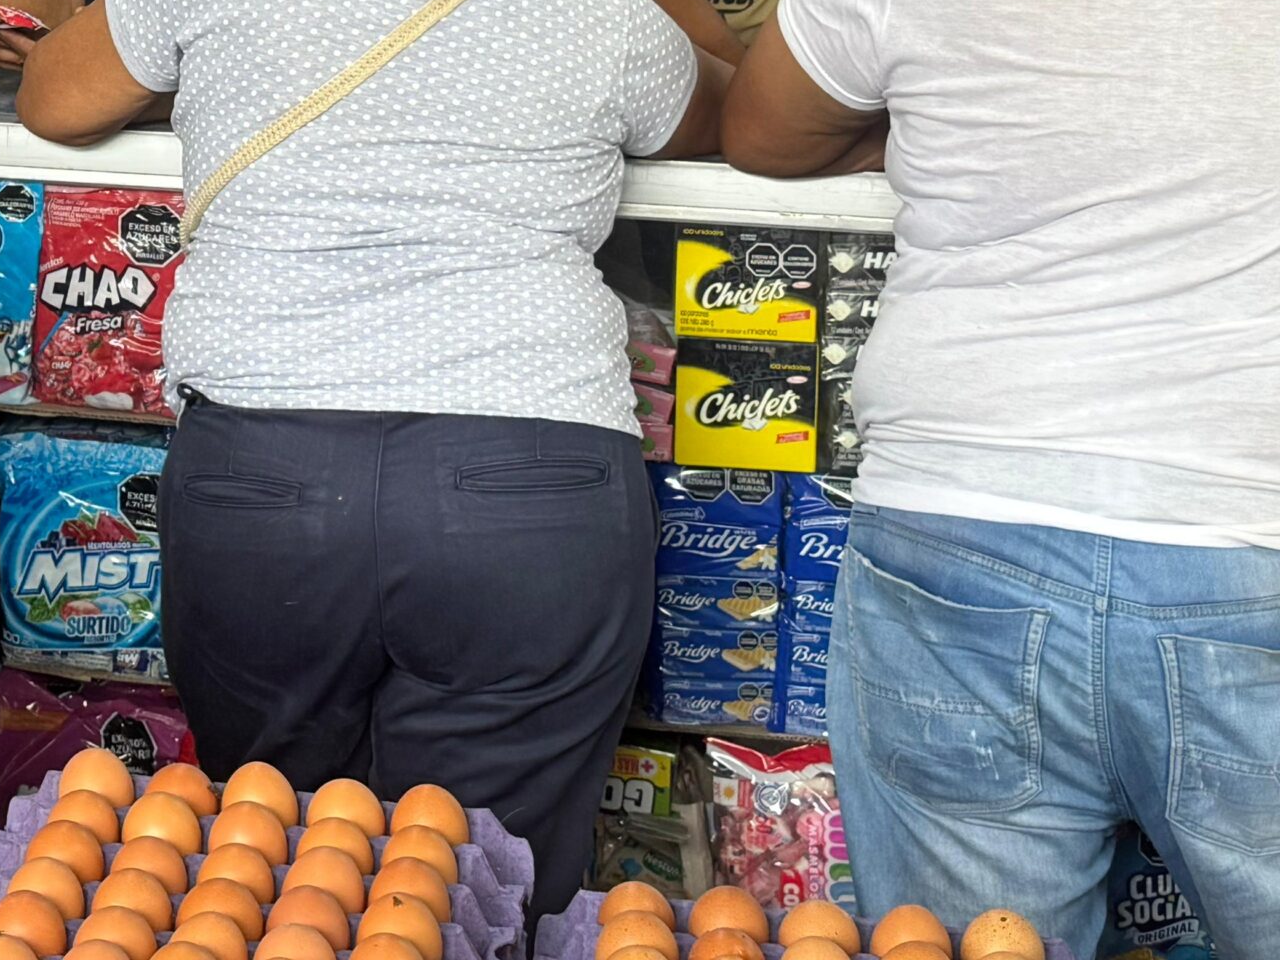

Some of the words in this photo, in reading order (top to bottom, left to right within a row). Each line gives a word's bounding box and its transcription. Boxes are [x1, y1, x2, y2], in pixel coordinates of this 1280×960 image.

[128, 222, 162, 233] EXCESO
[41, 266, 156, 310] CHAO
[701, 277, 788, 309] Chiclets
[75, 315, 122, 335] Fresa
[699, 388, 800, 425] Chiclets
[737, 476, 766, 485] GRASAS
[661, 521, 758, 558] Bridge
[658, 588, 716, 609] Bridge
[65, 615, 132, 637] SURTIDO
[663, 640, 720, 663] Bridge
[664, 692, 720, 714] Bridge
[808, 824, 820, 900] MASMELOS
[1129, 874, 1182, 901] CLU
[1137, 921, 1196, 944] ORIGINAL
